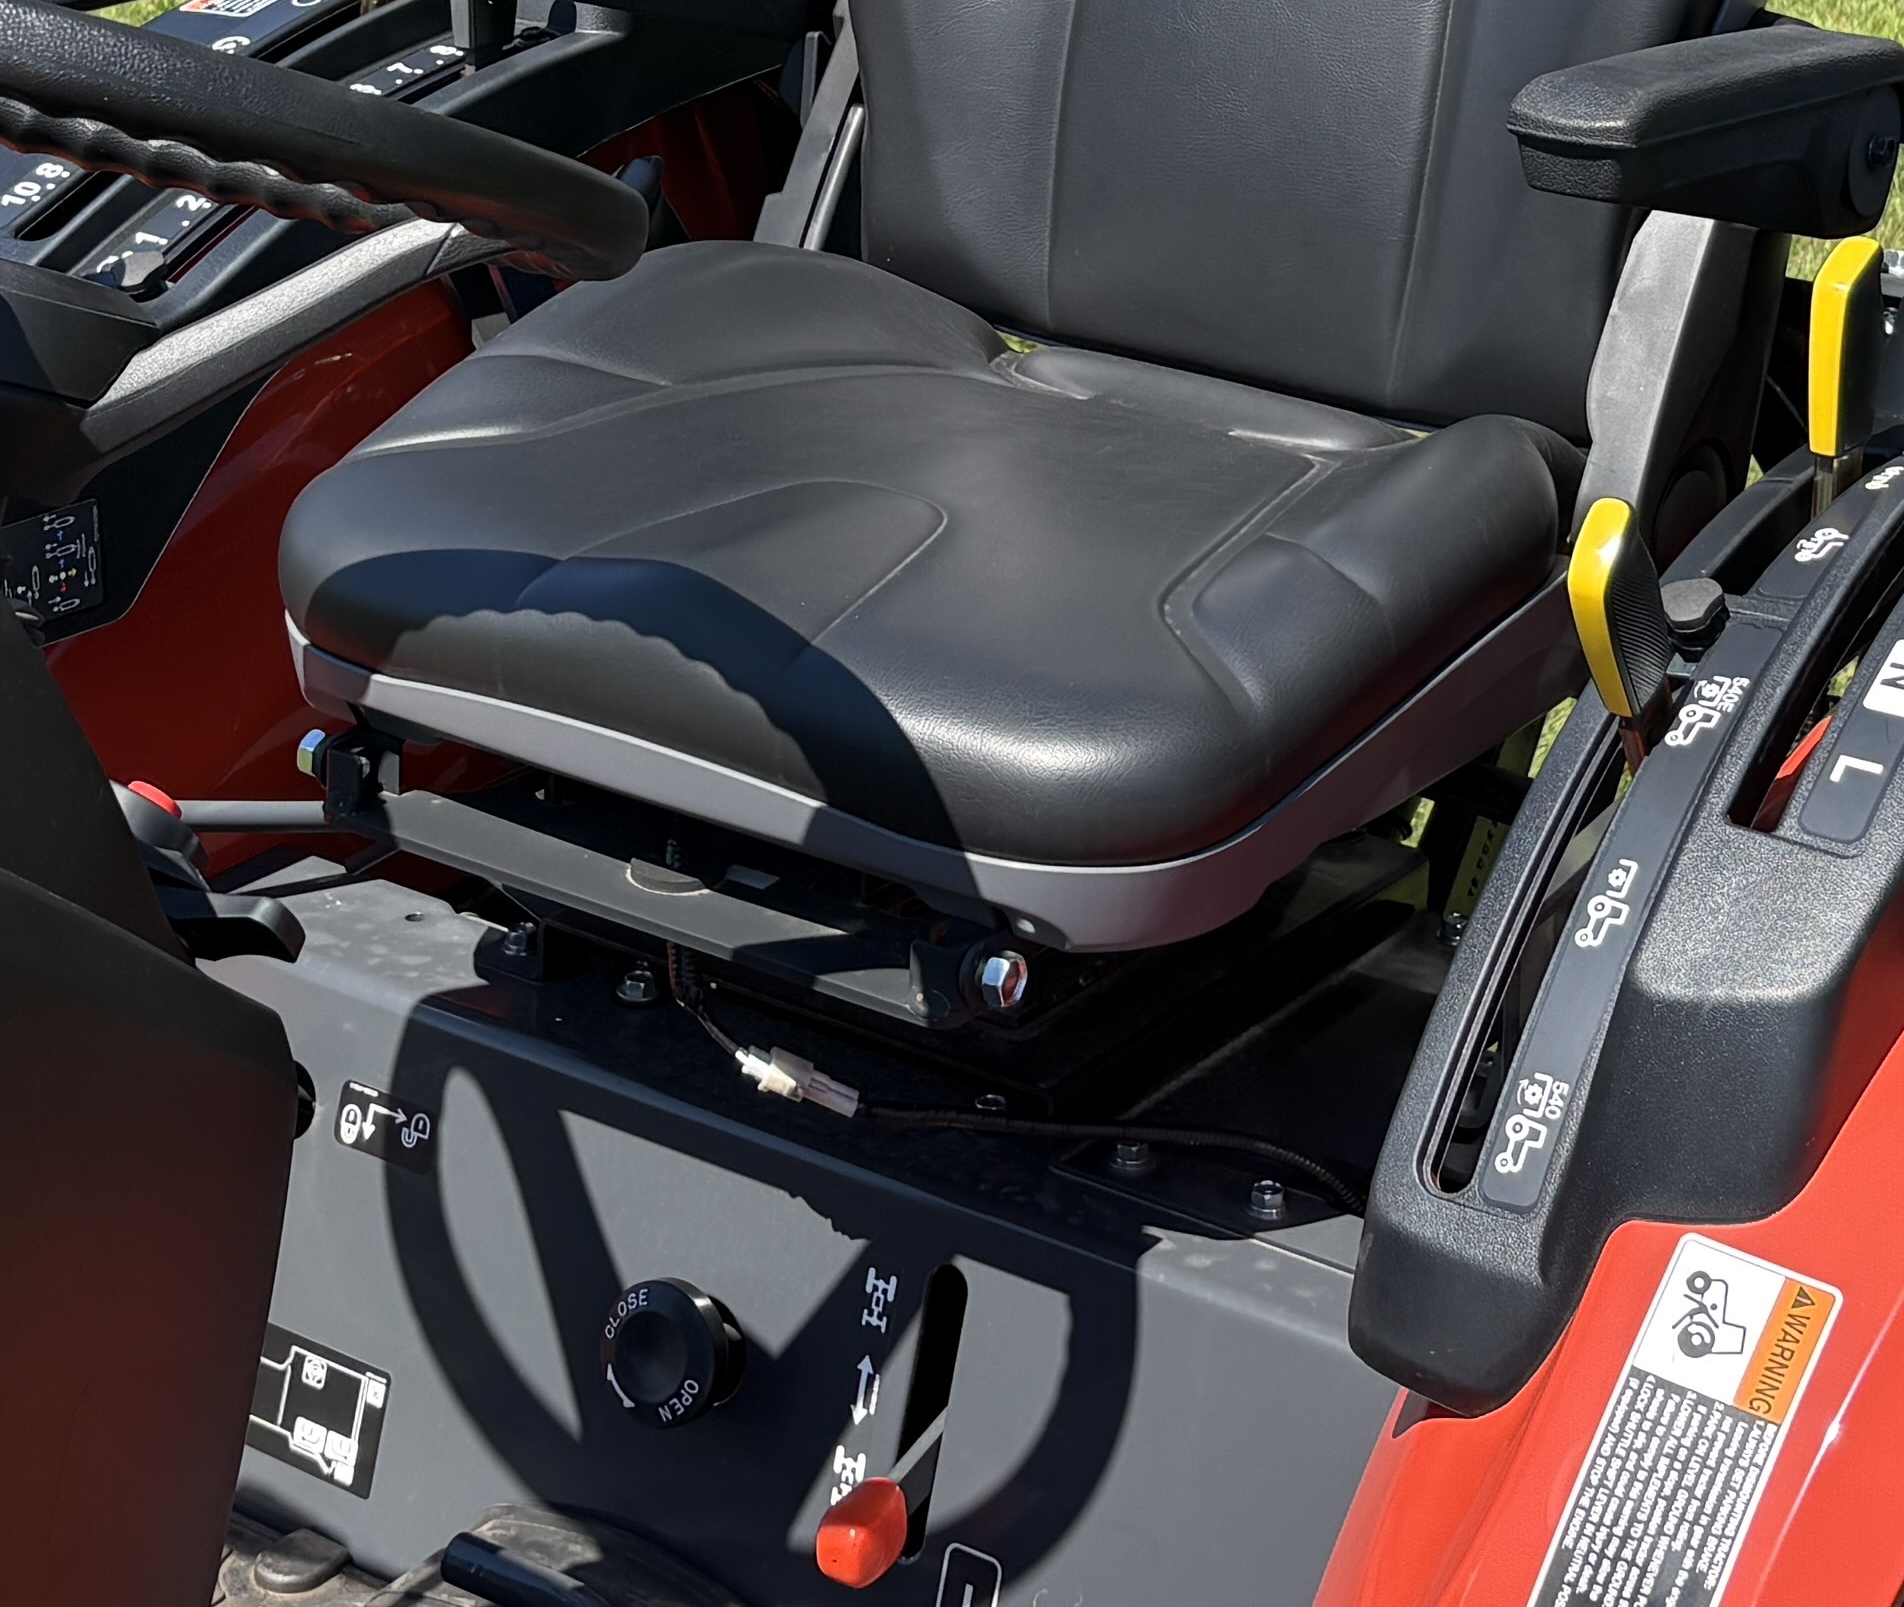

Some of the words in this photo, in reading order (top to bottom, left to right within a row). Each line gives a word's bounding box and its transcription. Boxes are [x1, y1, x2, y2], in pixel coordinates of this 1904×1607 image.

[1716, 676, 1751, 713] 540E
[1829, 754, 1885, 784] L
[1544, 1080, 1570, 1120] 540
[604, 1288, 649, 1339] CLOSE
[1750, 1314, 1810, 1413] WARNING
[658, 1379, 700, 1422] OPEN
